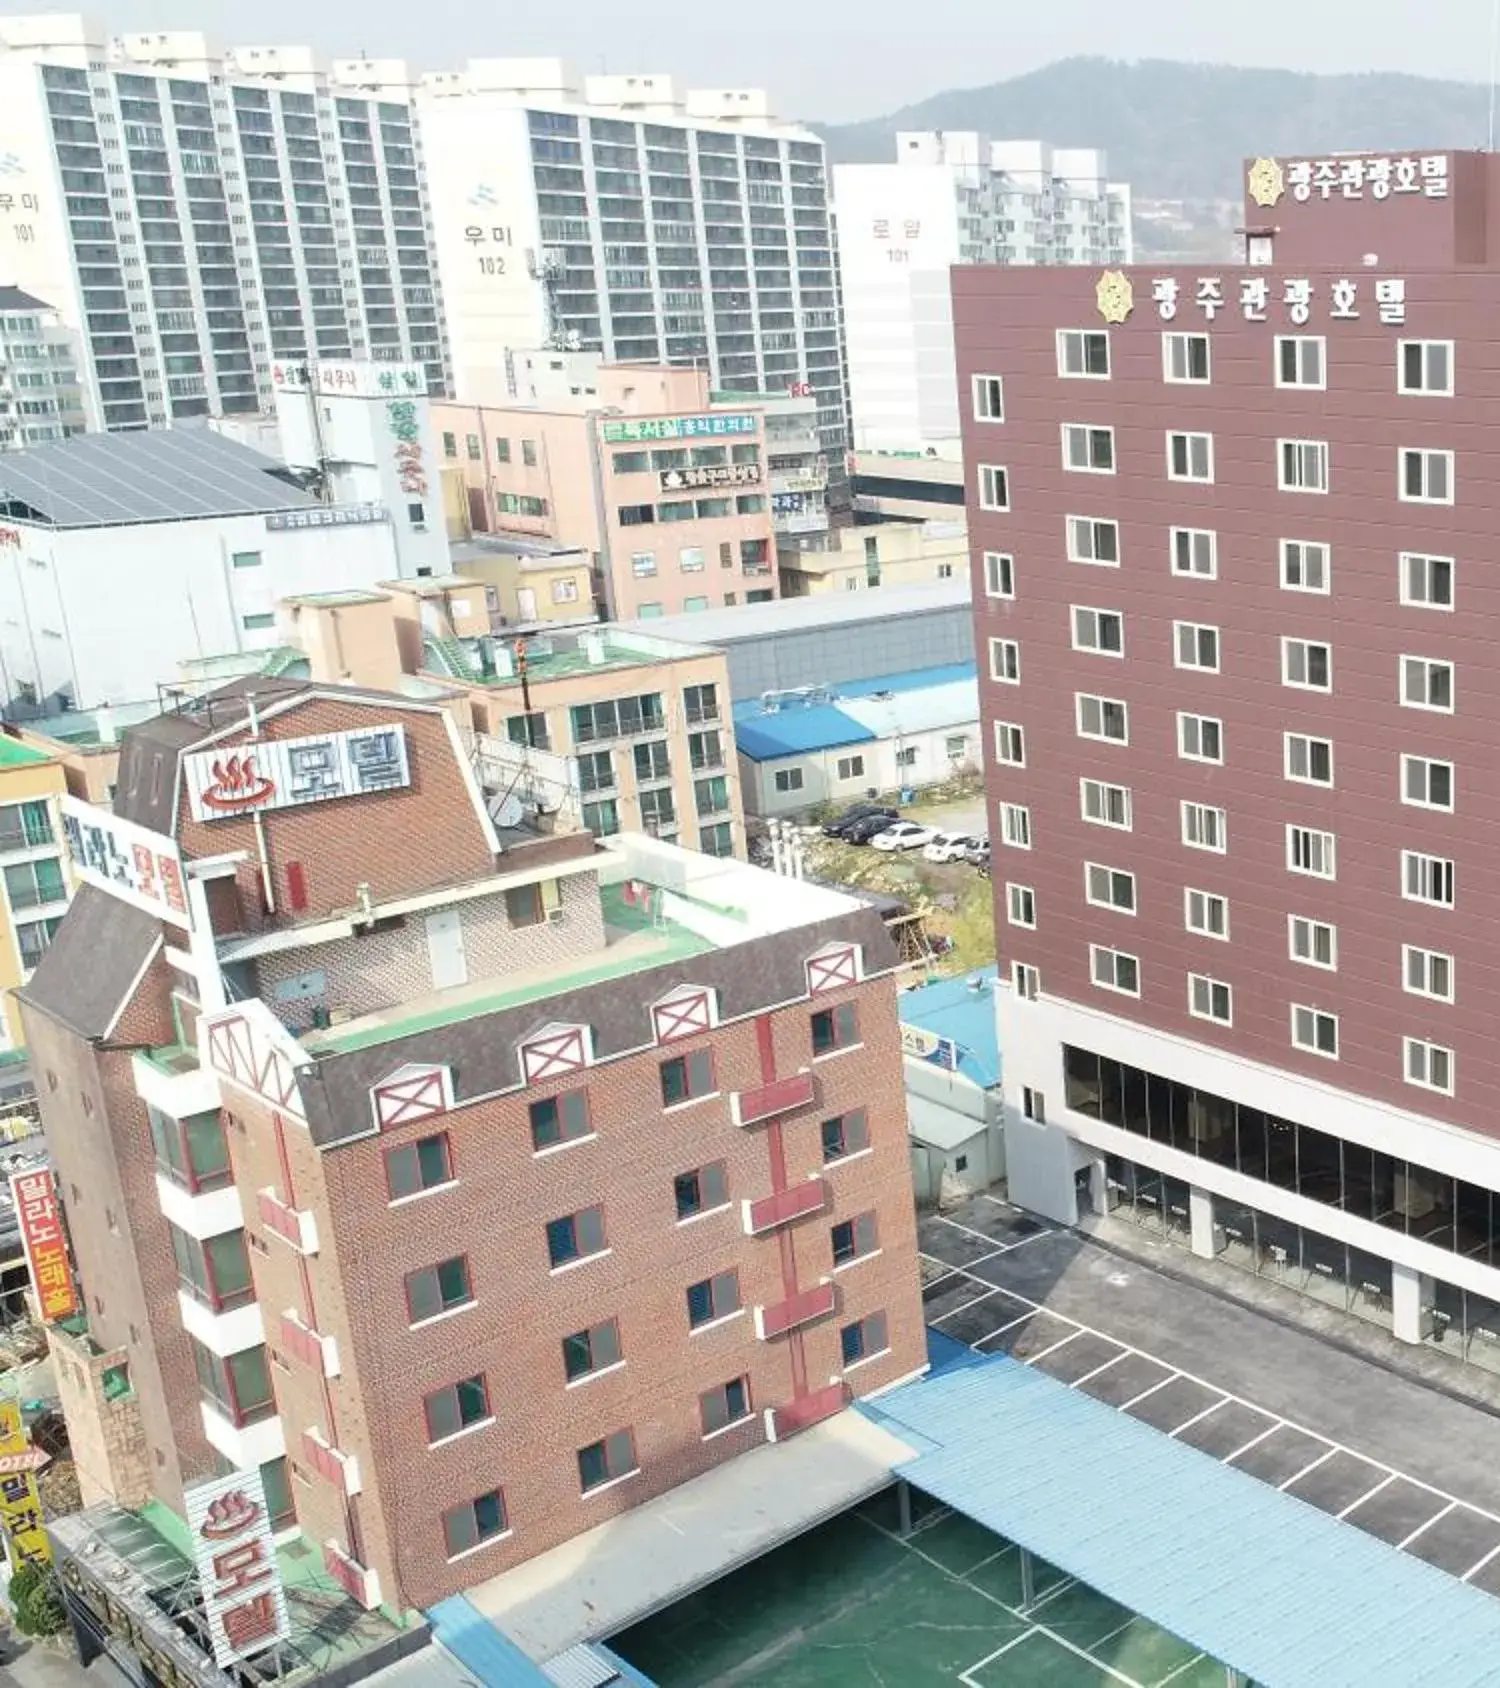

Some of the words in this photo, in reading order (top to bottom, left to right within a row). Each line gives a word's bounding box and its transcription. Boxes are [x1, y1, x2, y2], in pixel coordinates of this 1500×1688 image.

[1287, 155, 1449, 202] 광주관광호텔
[464, 225, 513, 247] 우미
[479, 256, 505, 275] 102
[1151, 278, 1406, 325] 광주관광호텔
[288, 731, 403, 799] 모텔
[212, 1538, 277, 1651] 모텔
